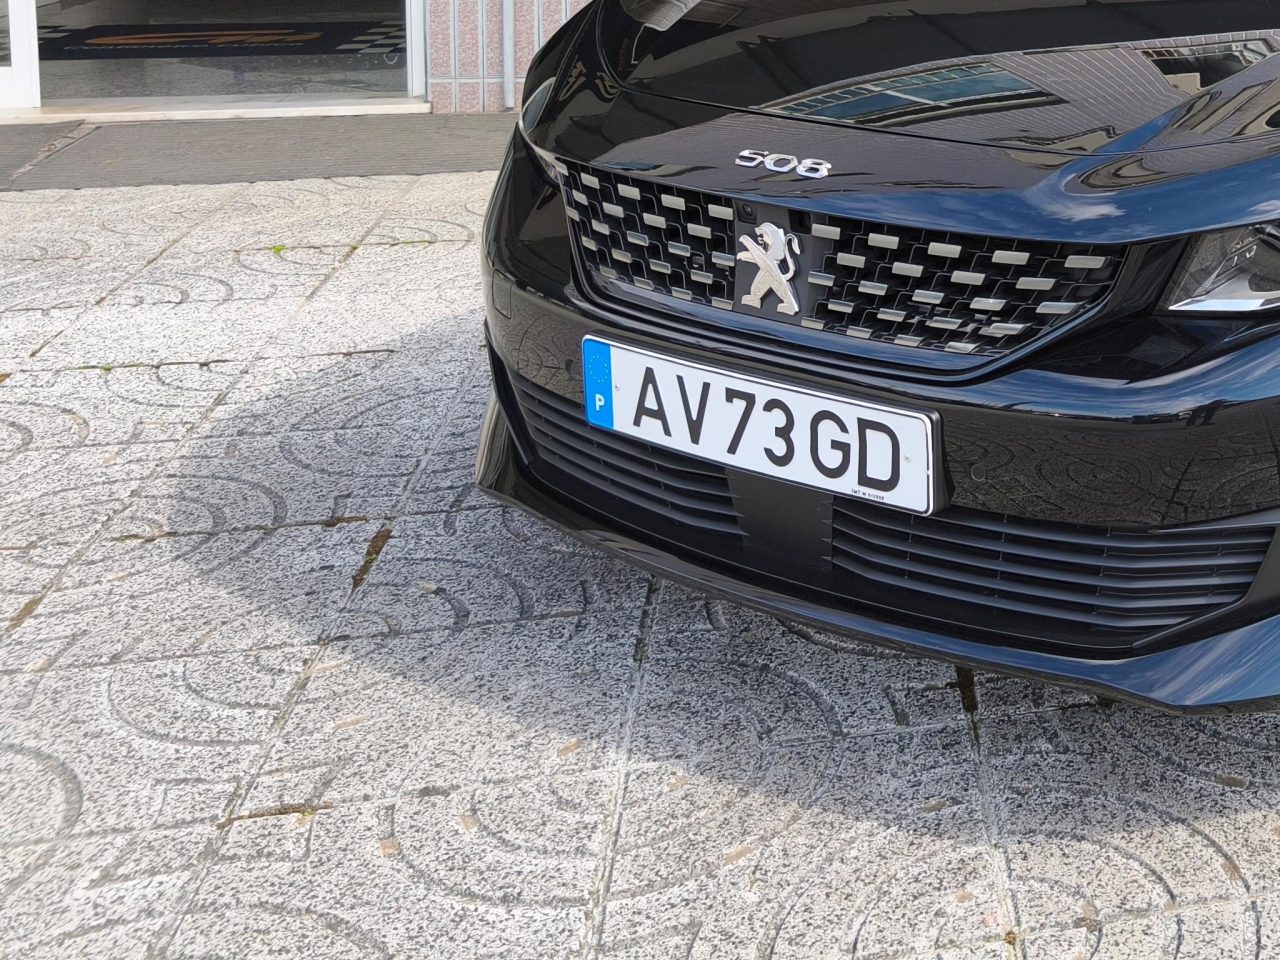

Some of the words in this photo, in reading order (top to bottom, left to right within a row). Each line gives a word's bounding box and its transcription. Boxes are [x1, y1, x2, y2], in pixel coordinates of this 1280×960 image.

[735, 149, 832, 179] 508
[595, 393, 605, 412] P
[632, 366, 901, 493] AV73GD
